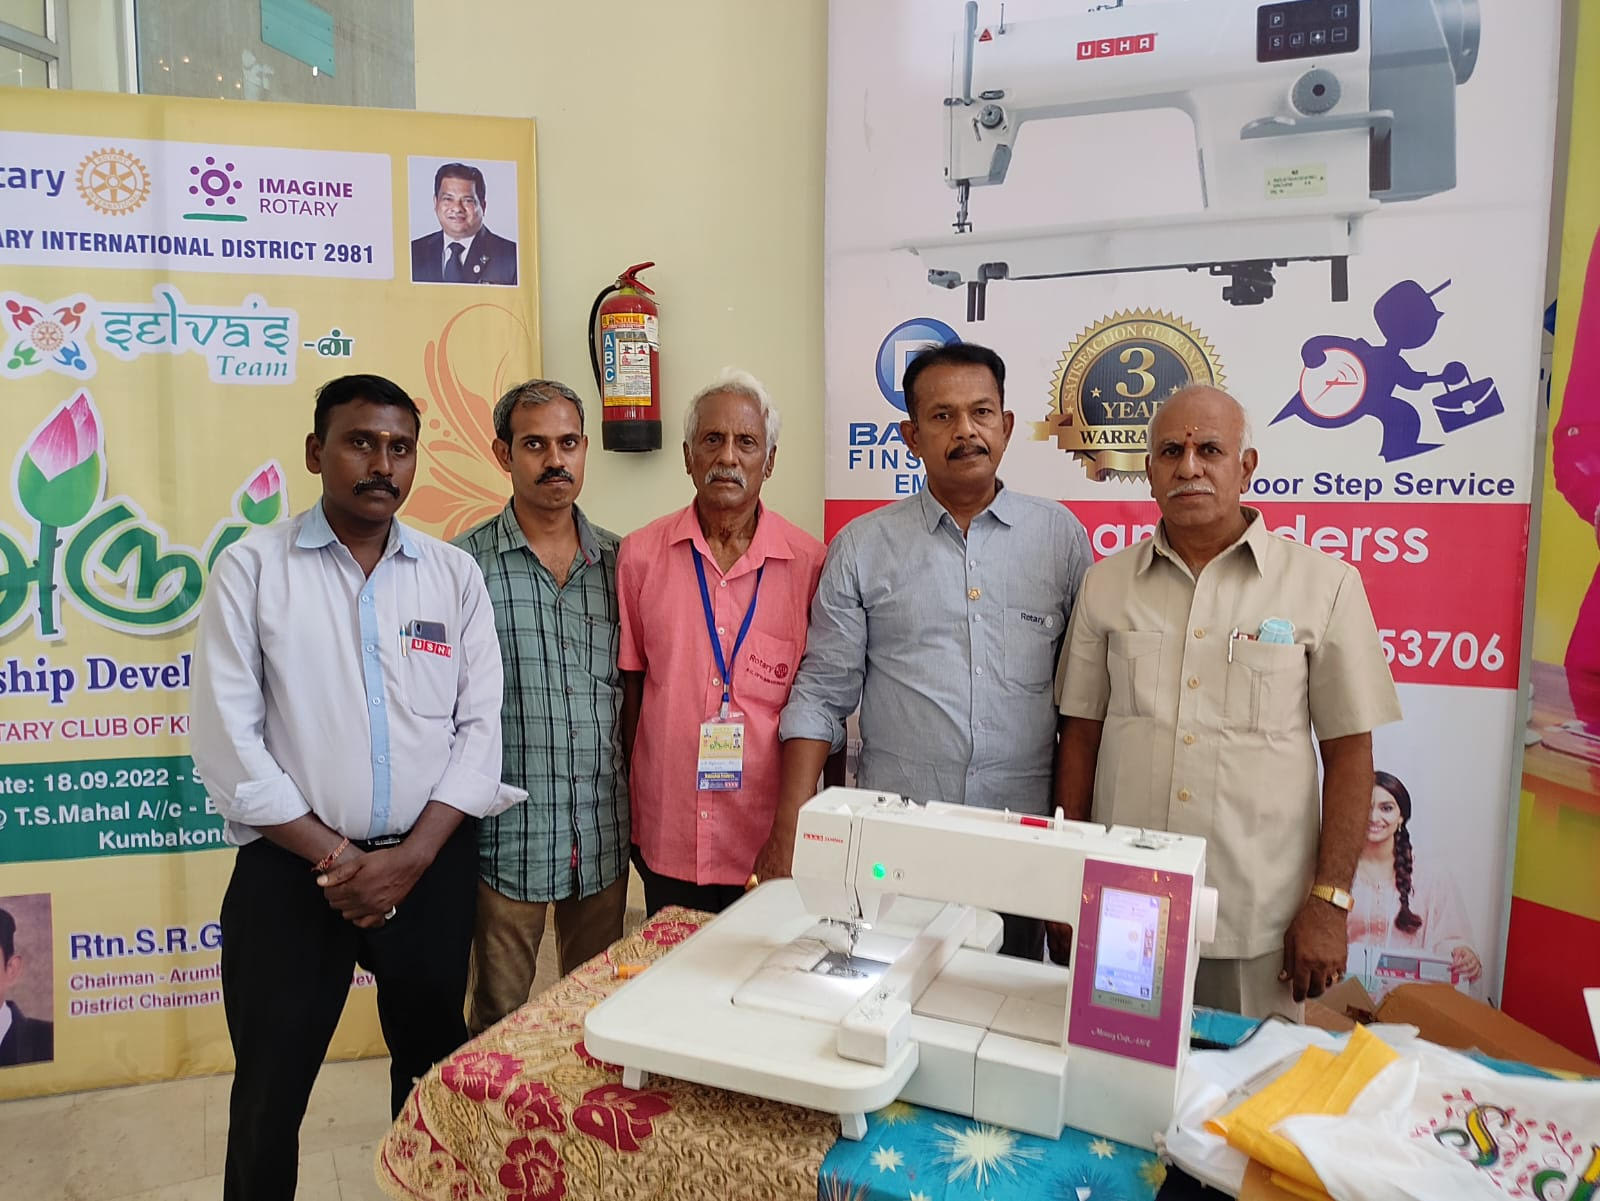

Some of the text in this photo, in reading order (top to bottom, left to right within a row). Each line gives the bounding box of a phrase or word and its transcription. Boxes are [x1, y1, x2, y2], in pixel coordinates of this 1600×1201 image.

[1079, 35, 1152, 58] USHA
[259, 178, 353, 198] IMAGINE
[260, 199, 339, 217] ROTARY
[41, 231, 214, 257] INTERNATIONAL
[222, 239, 317, 261] DISTRICT
[323, 243, 374, 264] 2981
[216, 355, 288, 377] Team
[1065, 325, 1137, 400] SATISFACTION
[1115, 347, 1157, 398] 3
[849, 422, 906, 446] BA
[1080, 430, 1147, 445] WARRA
[849, 449, 921, 470] FINS
[895, 474, 927, 494] EM
[1248, 472, 1515, 502] oor Step Service
[1271, 514, 1429, 564] derss
[1020, 612, 1045, 626] Rotary
[1378, 629, 1505, 671] 53706
[749, 654, 774, 674] Rotary
[0, 654, 191, 703] ship Devel
[0, 720, 55, 741] TARY
[61, 717, 128, 739] CLUB
[133, 716, 164, 735] OF
[43, 768, 169, 792] 18.09.2022
[14, 801, 130, 826] T.S.Mahal
[138, 800, 182, 821] A//c
[99, 827, 226, 850] Kumbakon
[70, 924, 223, 961] Rtn.S.R.G
[70, 972, 154, 991] Chairman
[71, 990, 220, 1016] District Chairman
